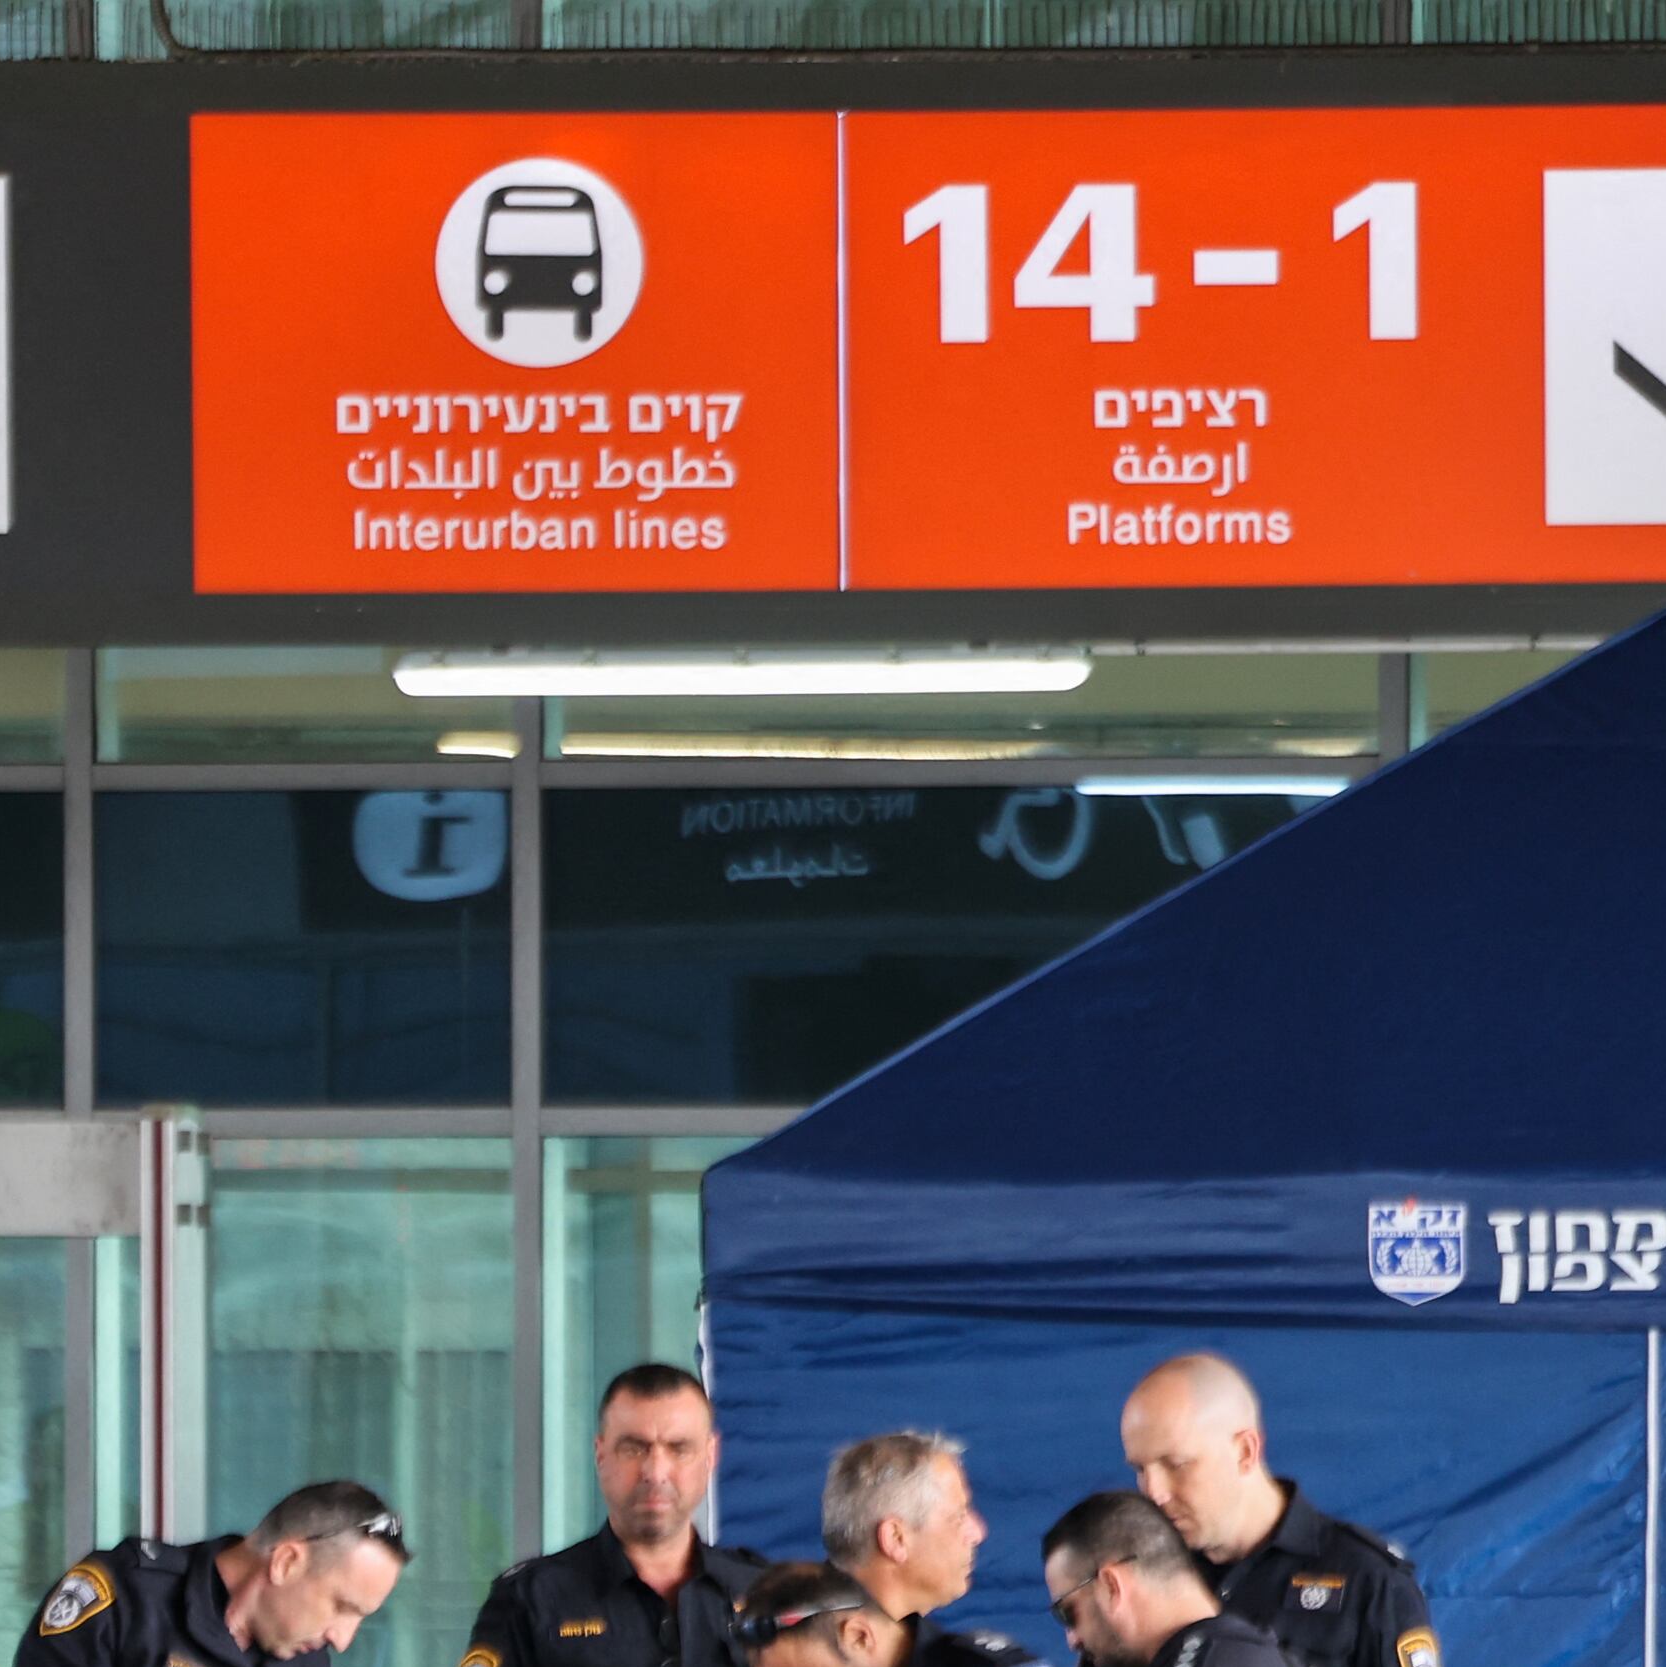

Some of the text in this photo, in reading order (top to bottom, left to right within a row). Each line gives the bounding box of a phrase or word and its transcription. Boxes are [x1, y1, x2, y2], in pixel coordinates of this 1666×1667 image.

[336, 394, 742, 443] קוים בינעירוניים
[1093, 388, 1268, 428] רציפים
[346, 447, 737, 501] خطوط بين البلدات
[353, 510, 726, 550] Interurban lines
[1067, 504, 1291, 545] Platforms
[1497, 1252, 1661, 1304] צפון
